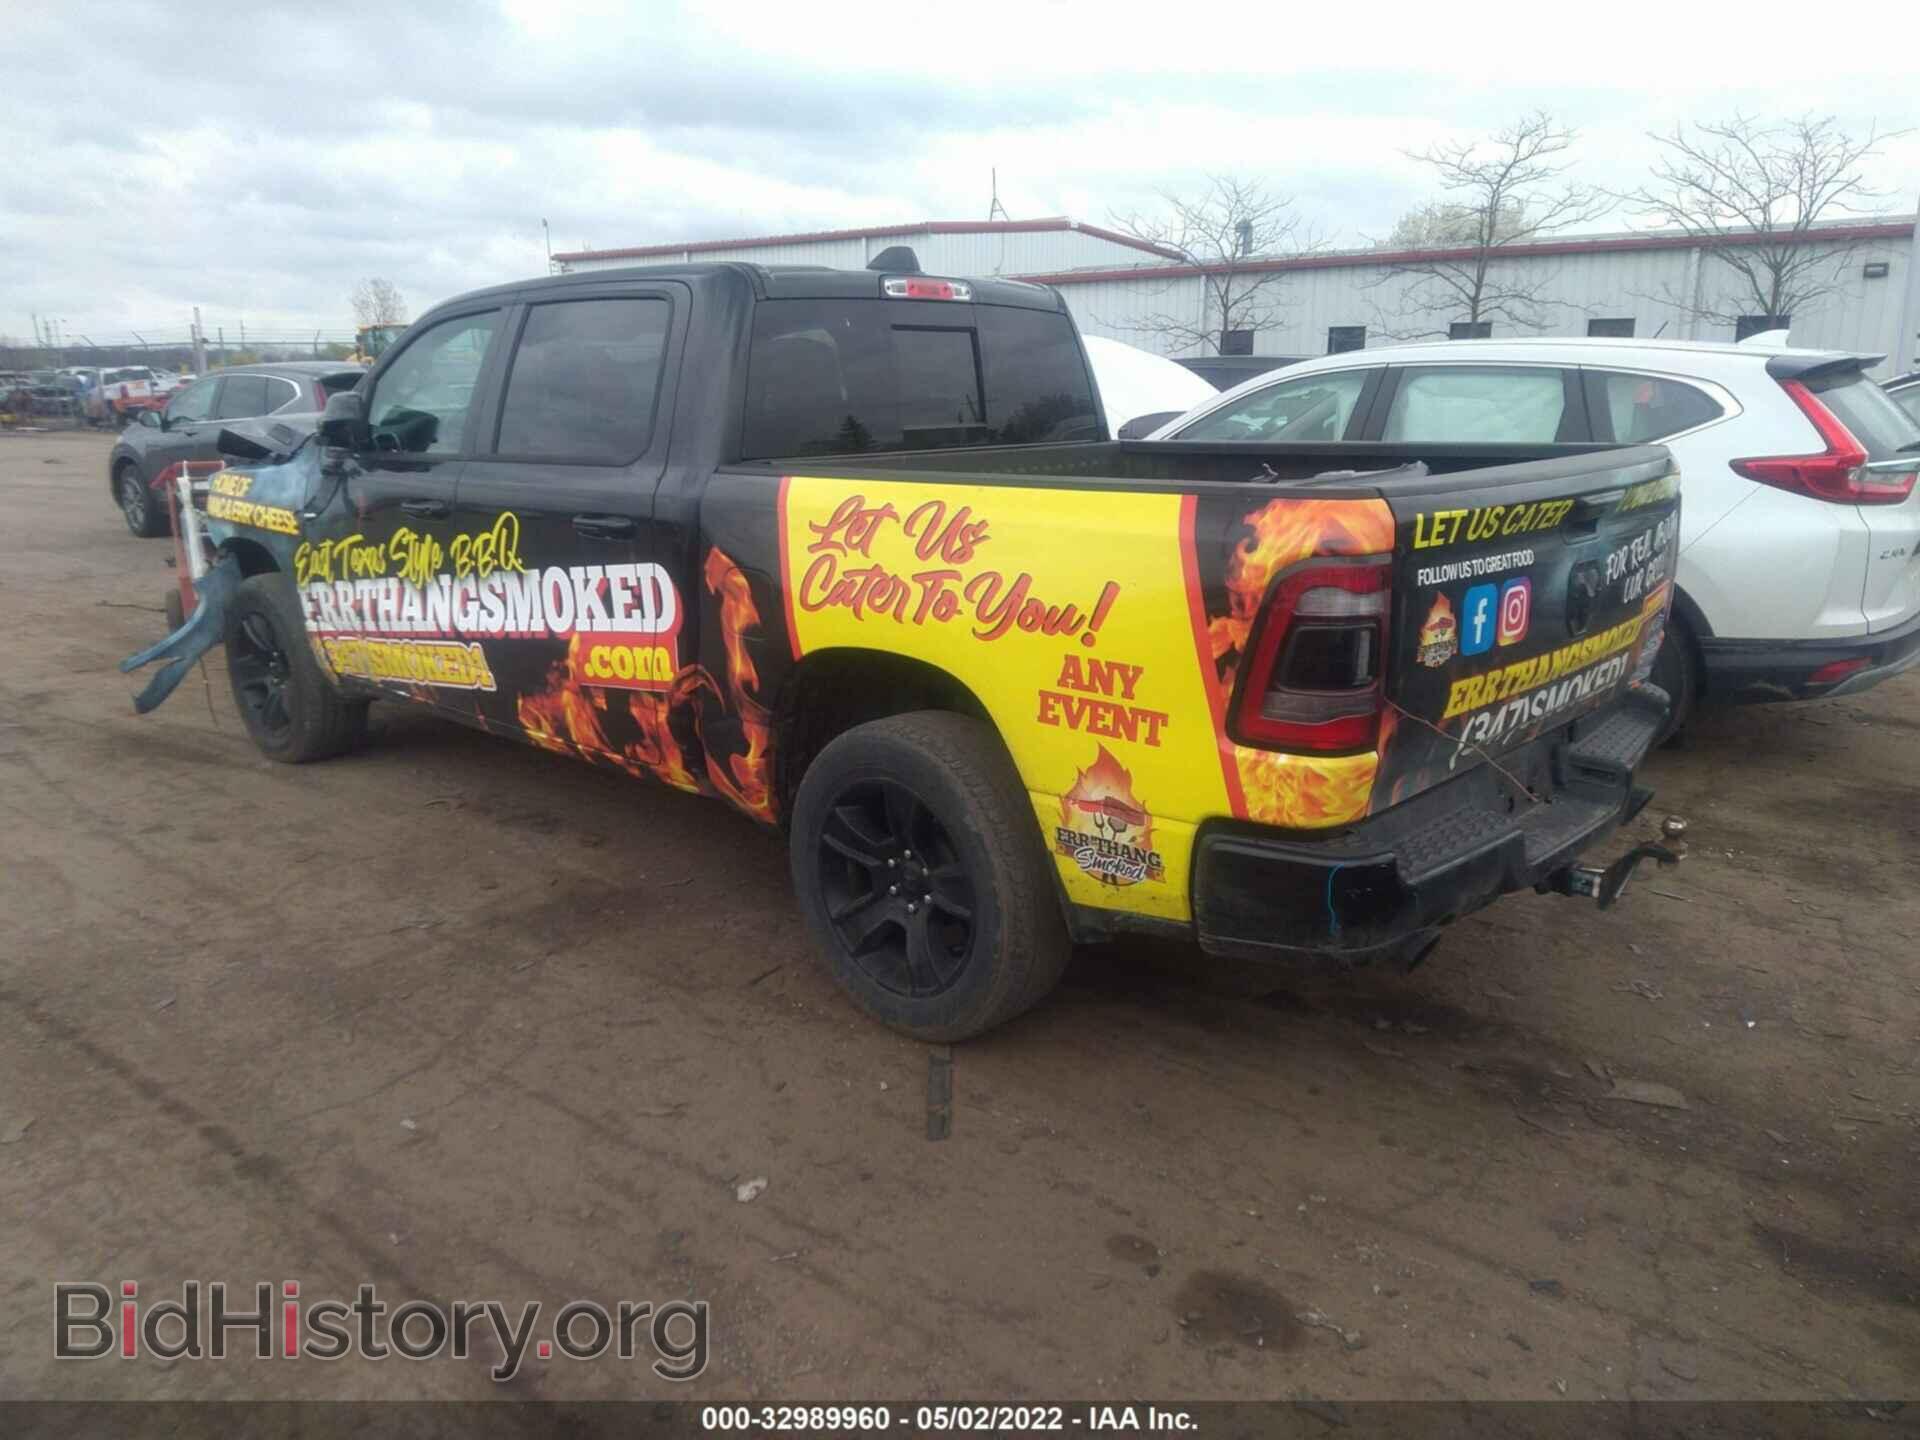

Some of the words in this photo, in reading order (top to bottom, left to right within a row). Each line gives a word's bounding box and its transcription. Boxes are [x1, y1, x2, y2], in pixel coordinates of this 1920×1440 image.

[807, 495, 900, 559] Let
[903, 500, 992, 565] Us
[1414, 509, 1468, 549] LET
[1466, 506, 1505, 541] US
[1502, 499, 1575, 535] CATER
[295, 540, 334, 588] East
[333, 534, 387, 582] Texas
[389, 527, 443, 589] Style
[1417, 564, 1458, 586] FOLLOW
[1458, 560, 1472, 578] US
[1472, 558, 1485, 576] TO
[1485, 553, 1514, 574] GREAT
[1513, 549, 1535, 569] FOOD
[298, 562, 677, 634] ERRTHANGSMOKED
[800, 554, 912, 623] Cater
[911, 569, 964, 626] To
[963, 572, 1121, 648] You!
[584, 645, 674, 683] .com
[1057, 654, 1144, 700] ANY
[1037, 690, 1169, 748] EVENT
[1074, 846, 1147, 882] Smoked
